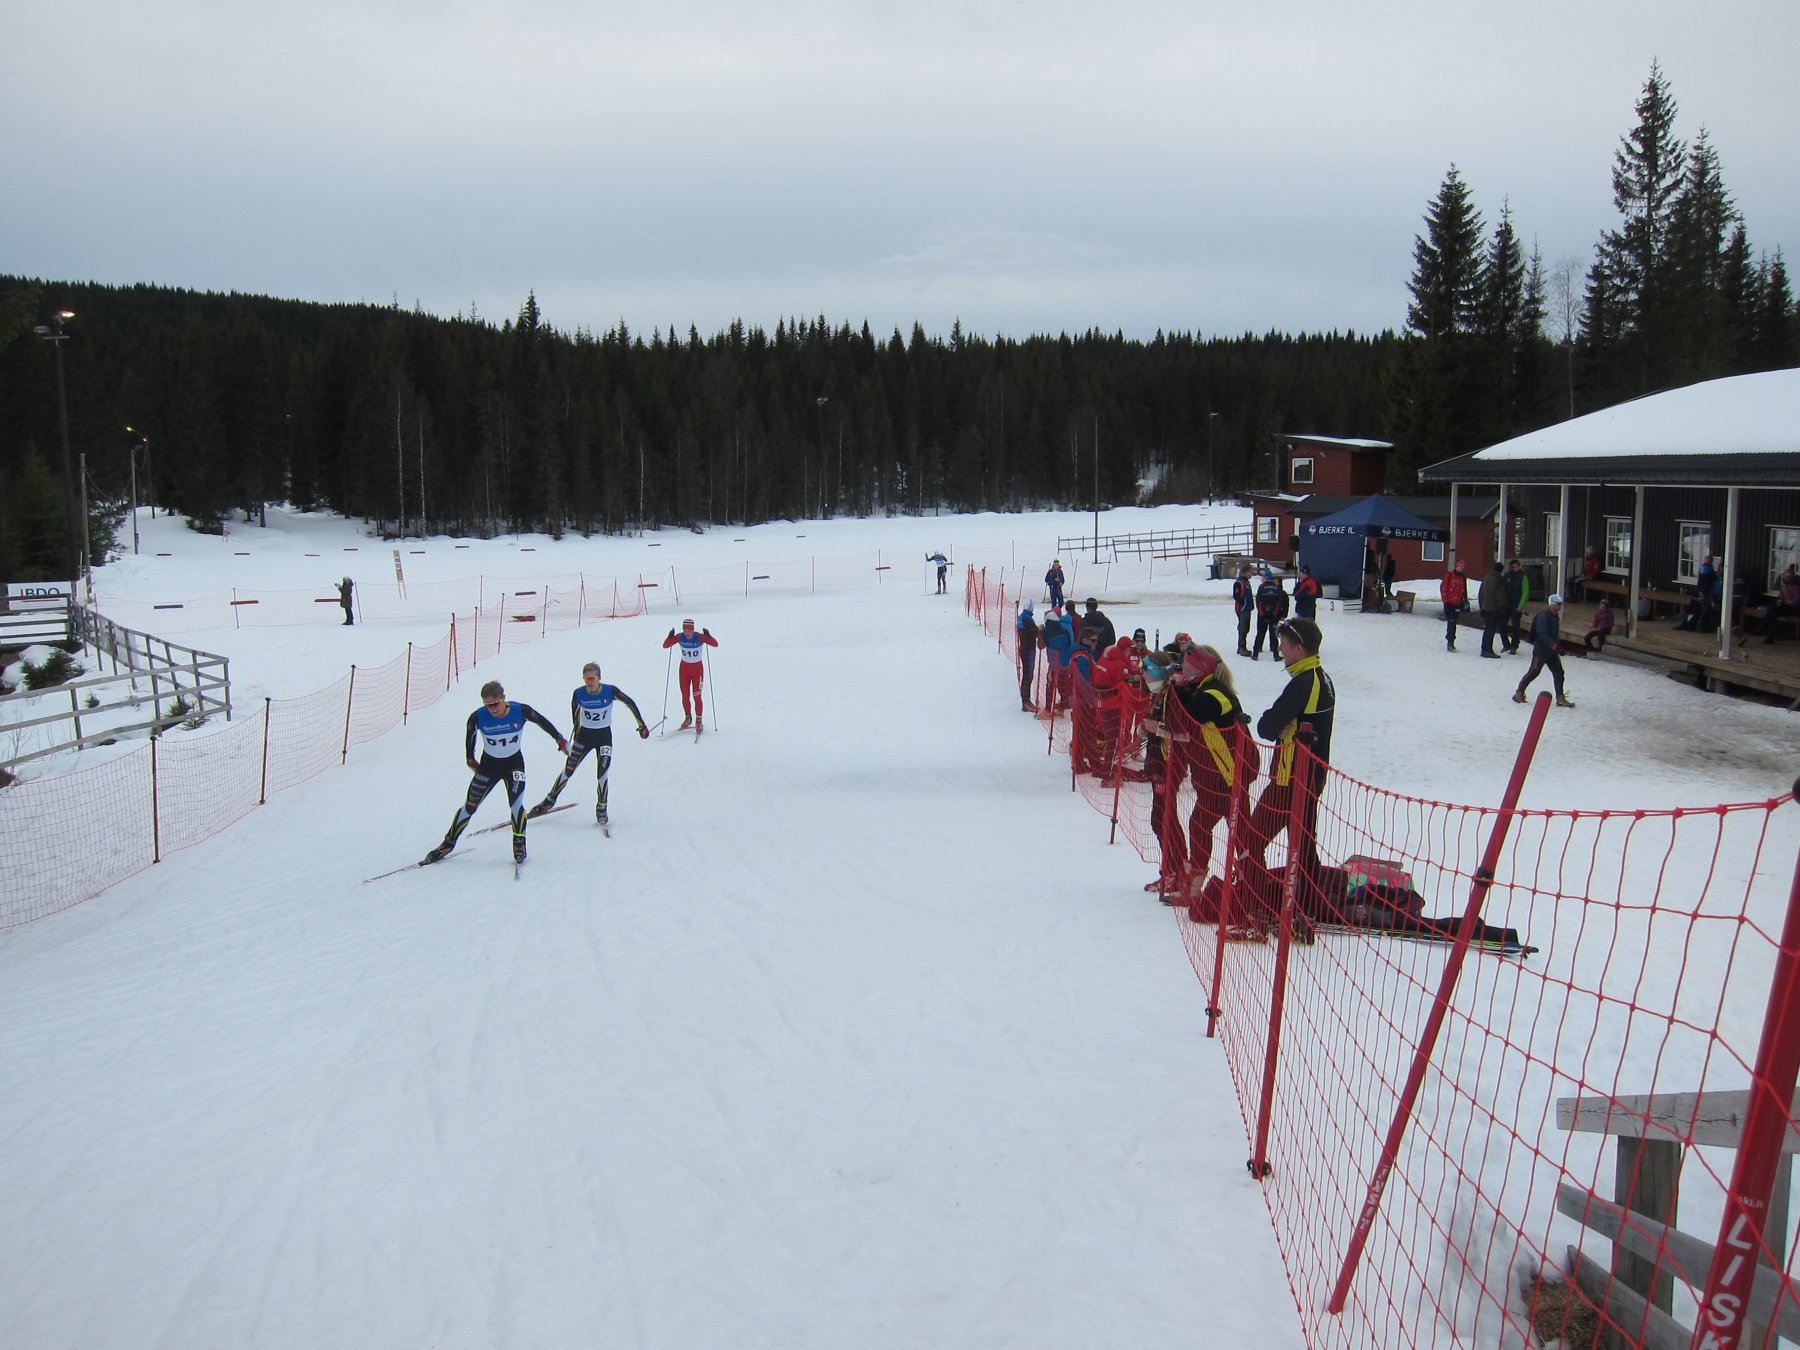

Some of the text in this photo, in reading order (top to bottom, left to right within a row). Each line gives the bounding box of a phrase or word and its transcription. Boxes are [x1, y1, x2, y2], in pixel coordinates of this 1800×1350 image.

[1318, 526, 1345, 535] BJERKE
[1395, 528, 1428, 539] BJERKE
[1329, 601, 1335, 612] 3
